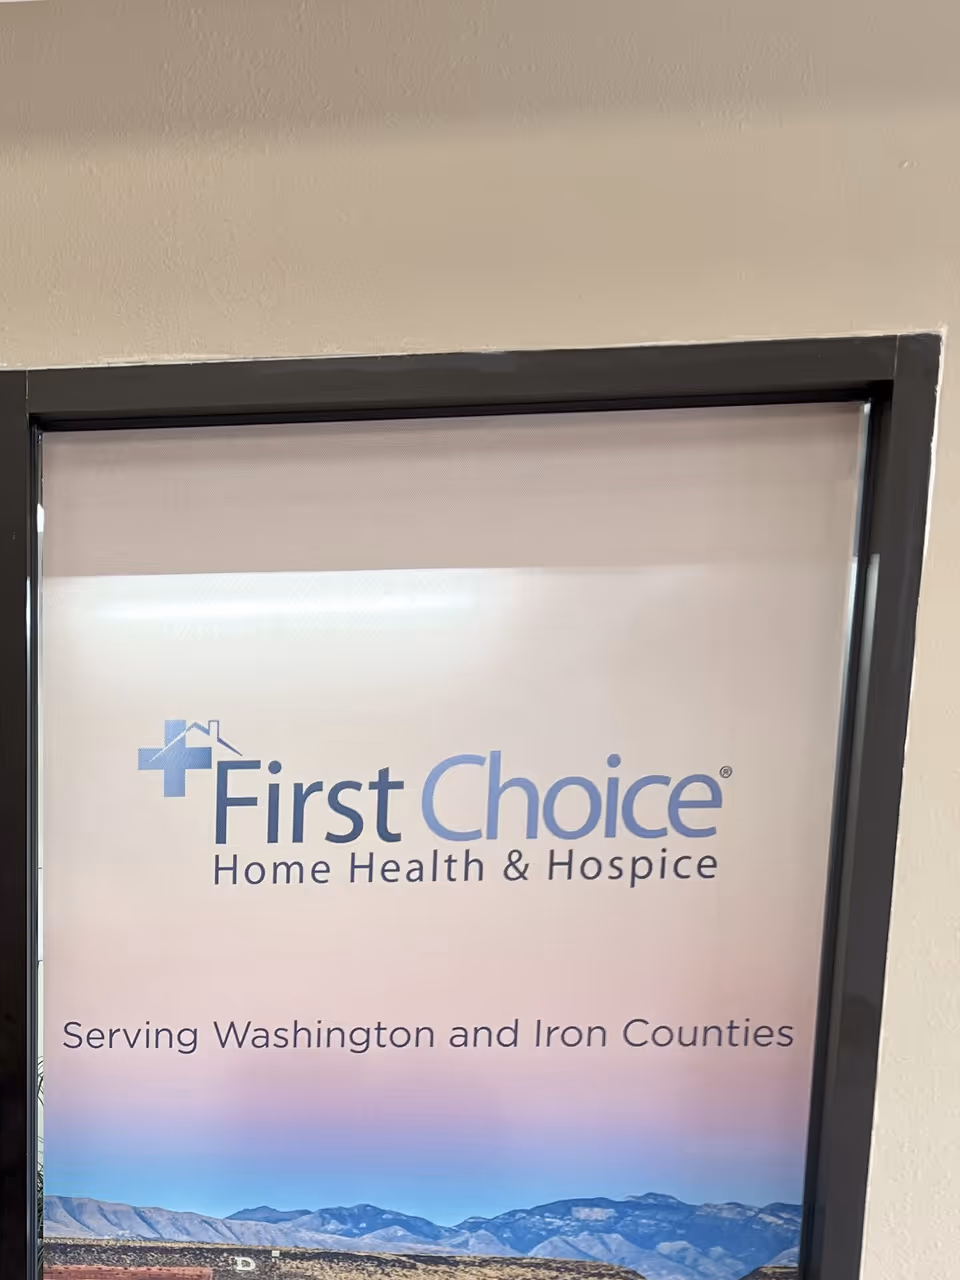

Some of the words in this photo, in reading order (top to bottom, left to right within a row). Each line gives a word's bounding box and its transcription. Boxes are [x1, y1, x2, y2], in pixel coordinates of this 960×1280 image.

[215, 760, 405, 844] First
[214, 854, 331, 885] Home
[349, 848, 484, 884] Health
[503, 849, 530, 881] &
[547, 847, 719, 889] Hospice
[62, 1021, 199, 1055] Serving
[212, 1018, 436, 1054] Washington
[448, 1018, 520, 1049] and
[534, 1018, 608, 1049] Iron
[622, 1018, 796, 1049] Counties
